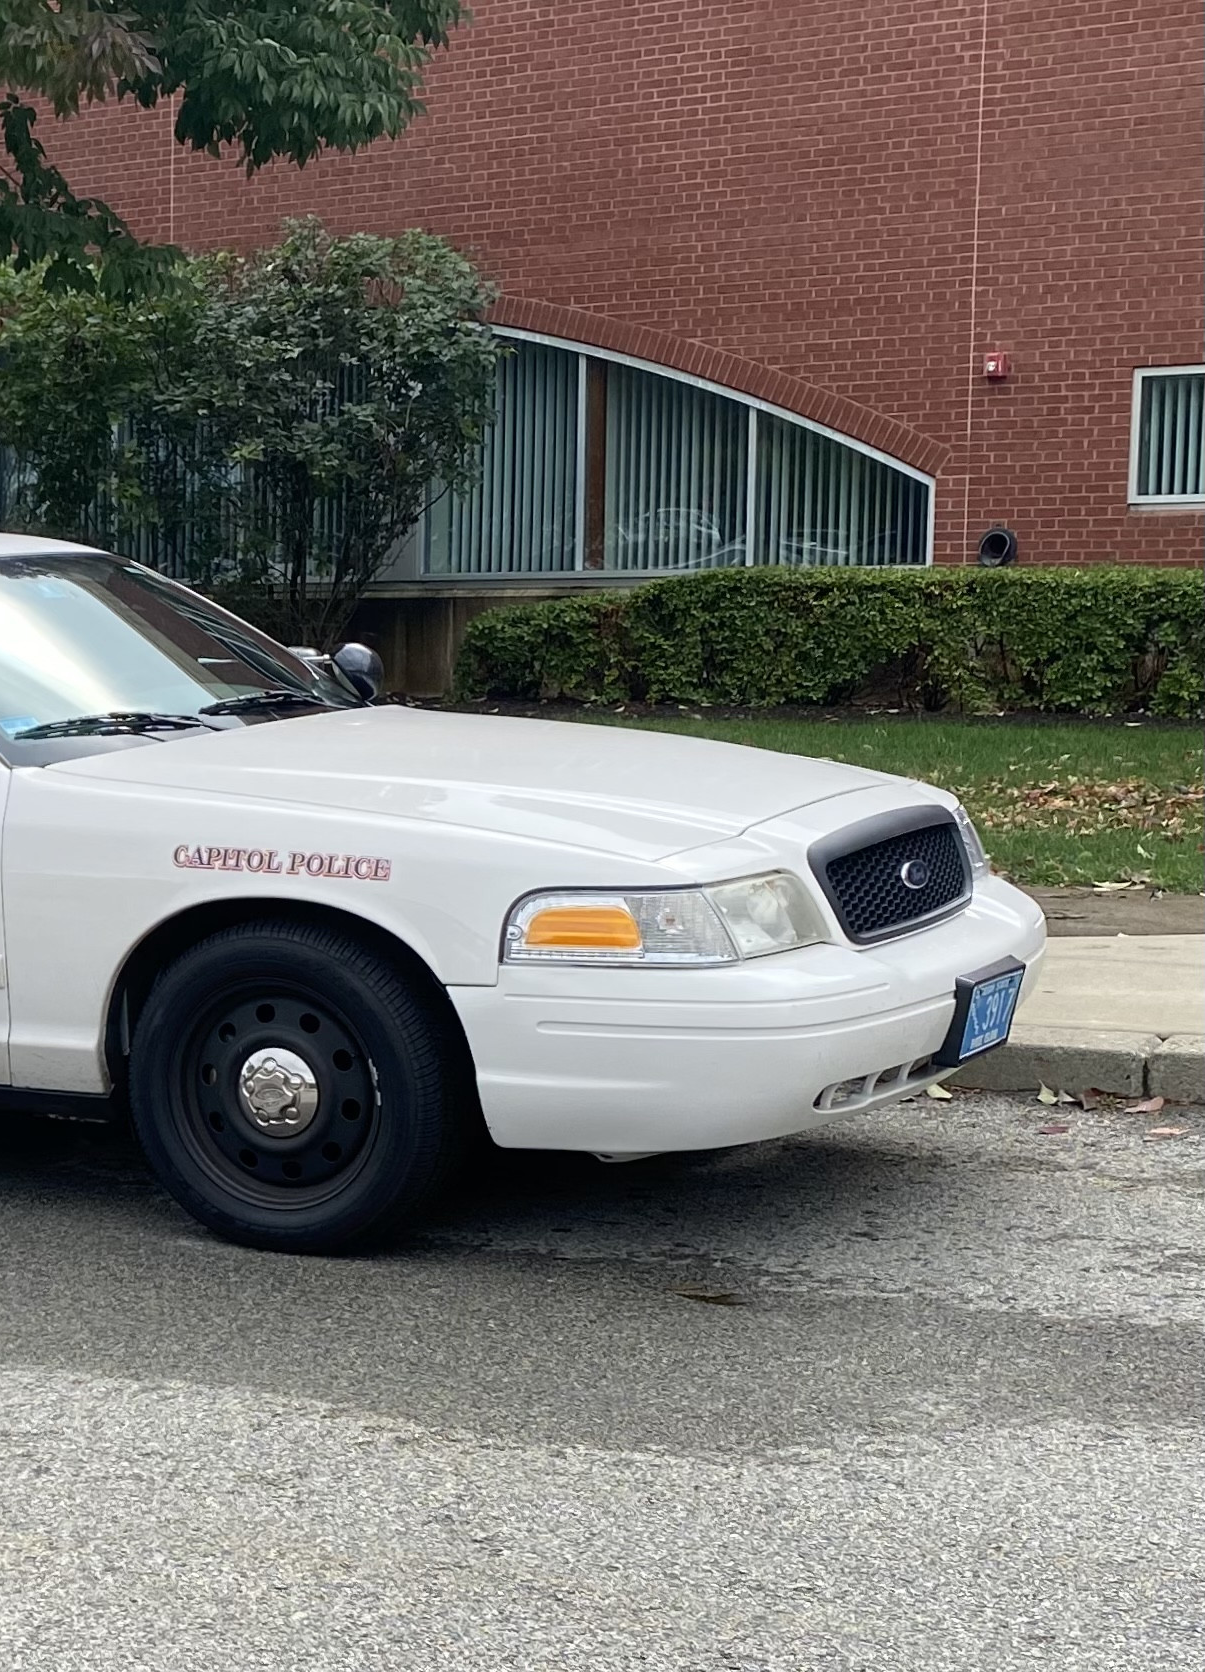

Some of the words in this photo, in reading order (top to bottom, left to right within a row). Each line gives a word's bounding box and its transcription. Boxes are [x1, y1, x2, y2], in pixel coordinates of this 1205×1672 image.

[172, 844, 282, 874] CAPITOL
[286, 850, 392, 882] POLICE
[982, 988, 1016, 1031] 3917
